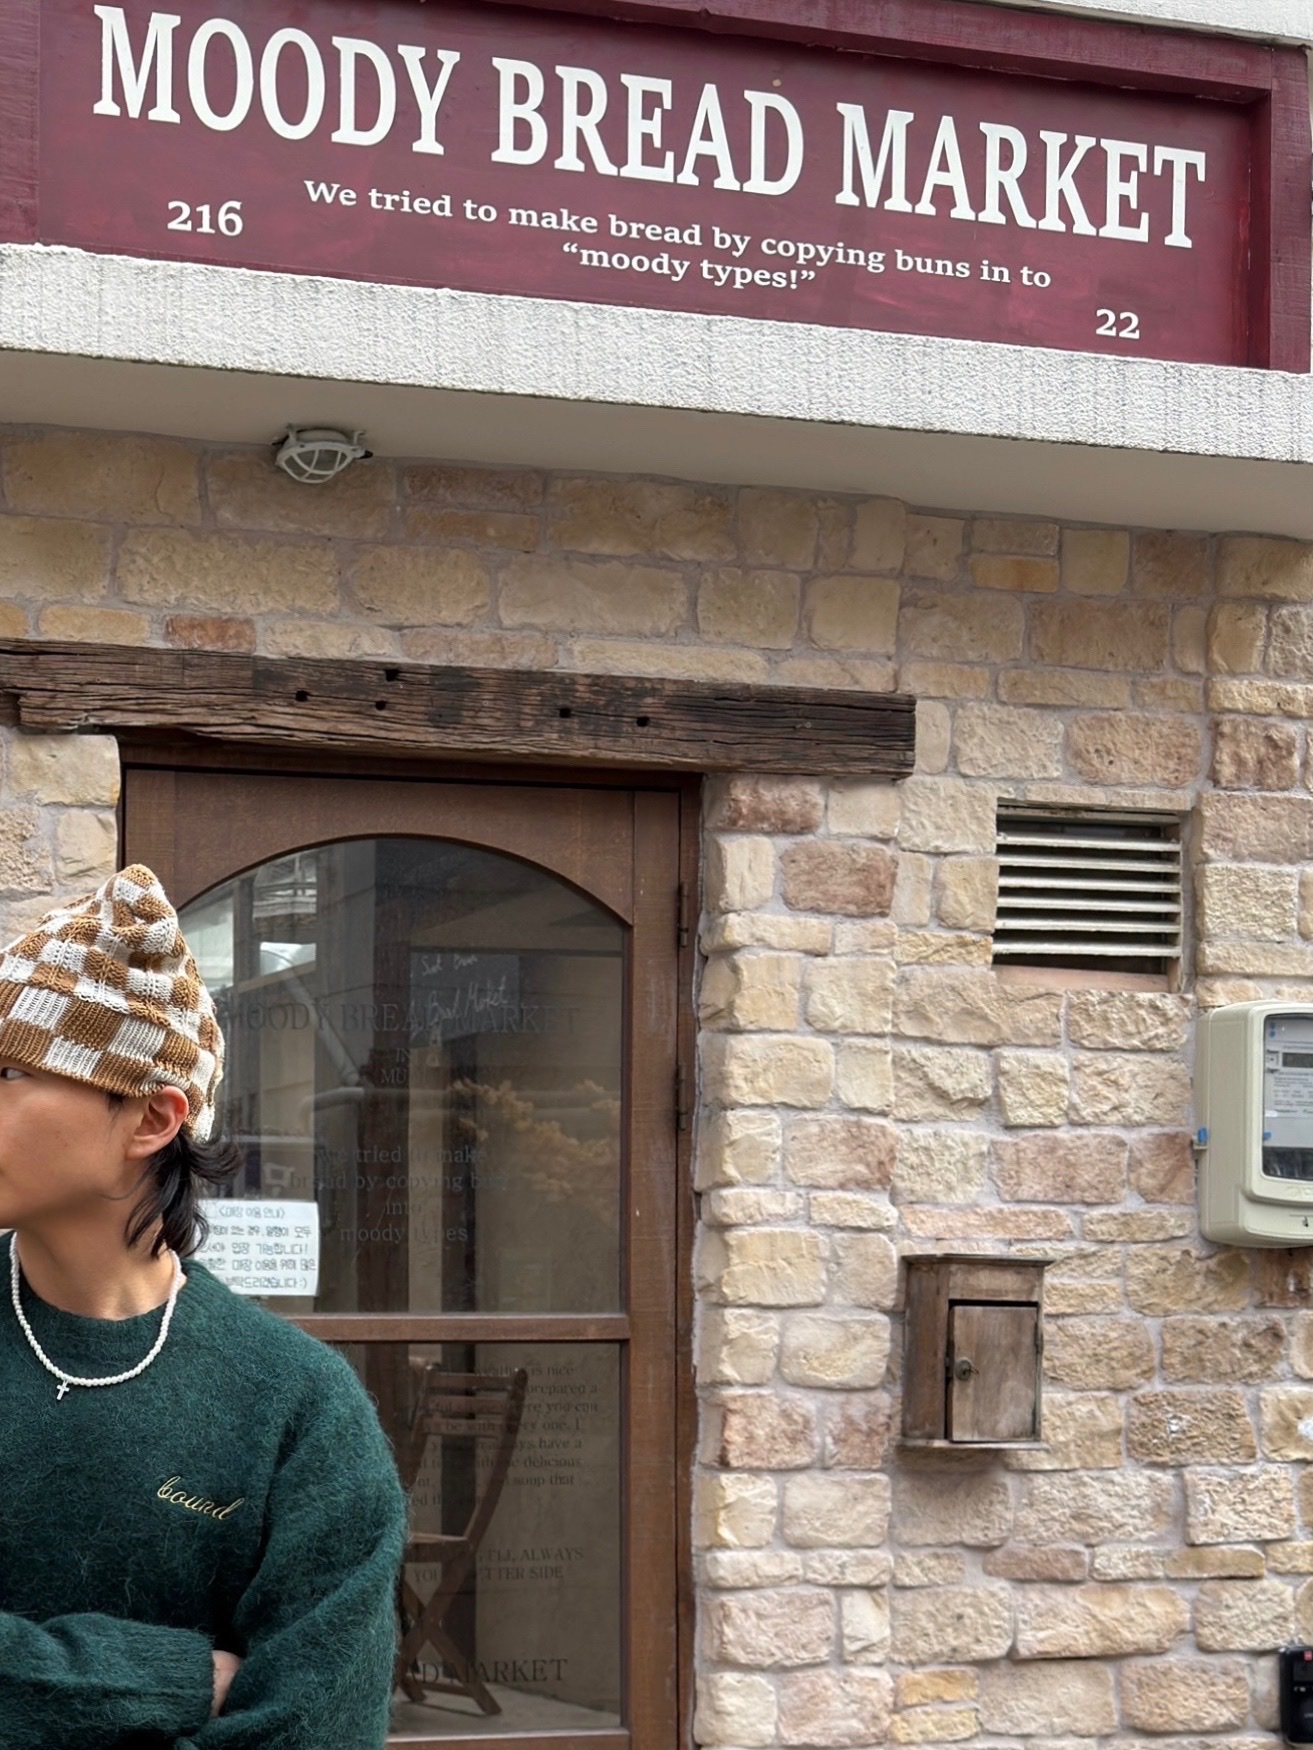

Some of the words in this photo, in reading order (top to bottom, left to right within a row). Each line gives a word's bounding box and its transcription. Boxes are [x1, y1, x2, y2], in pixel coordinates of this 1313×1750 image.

[93, 5, 460, 156] MOODY
[491, 56, 804, 196] BREAD
[835, 102, 1206, 249] MARKET
[167, 200, 244, 237] 216
[304, 180, 357, 207] We
[368, 188, 453, 218] tried
[463, 199, 498, 223] to
[509, 207, 599, 234] make
[608, 214, 702, 247] bread
[712, 226, 752, 257] by
[760, 237, 886, 273] copying
[895, 248, 971, 279] buns
[980, 259, 1011, 283] in
[1020, 265, 1052, 289] to
[1095, 309, 1141, 339] 22
[355, 1144, 402, 1164] tried
[355, 1171, 379, 1193] by
[339, 1224, 405, 1245] moody
[156, 1475, 246, 1520] bound
